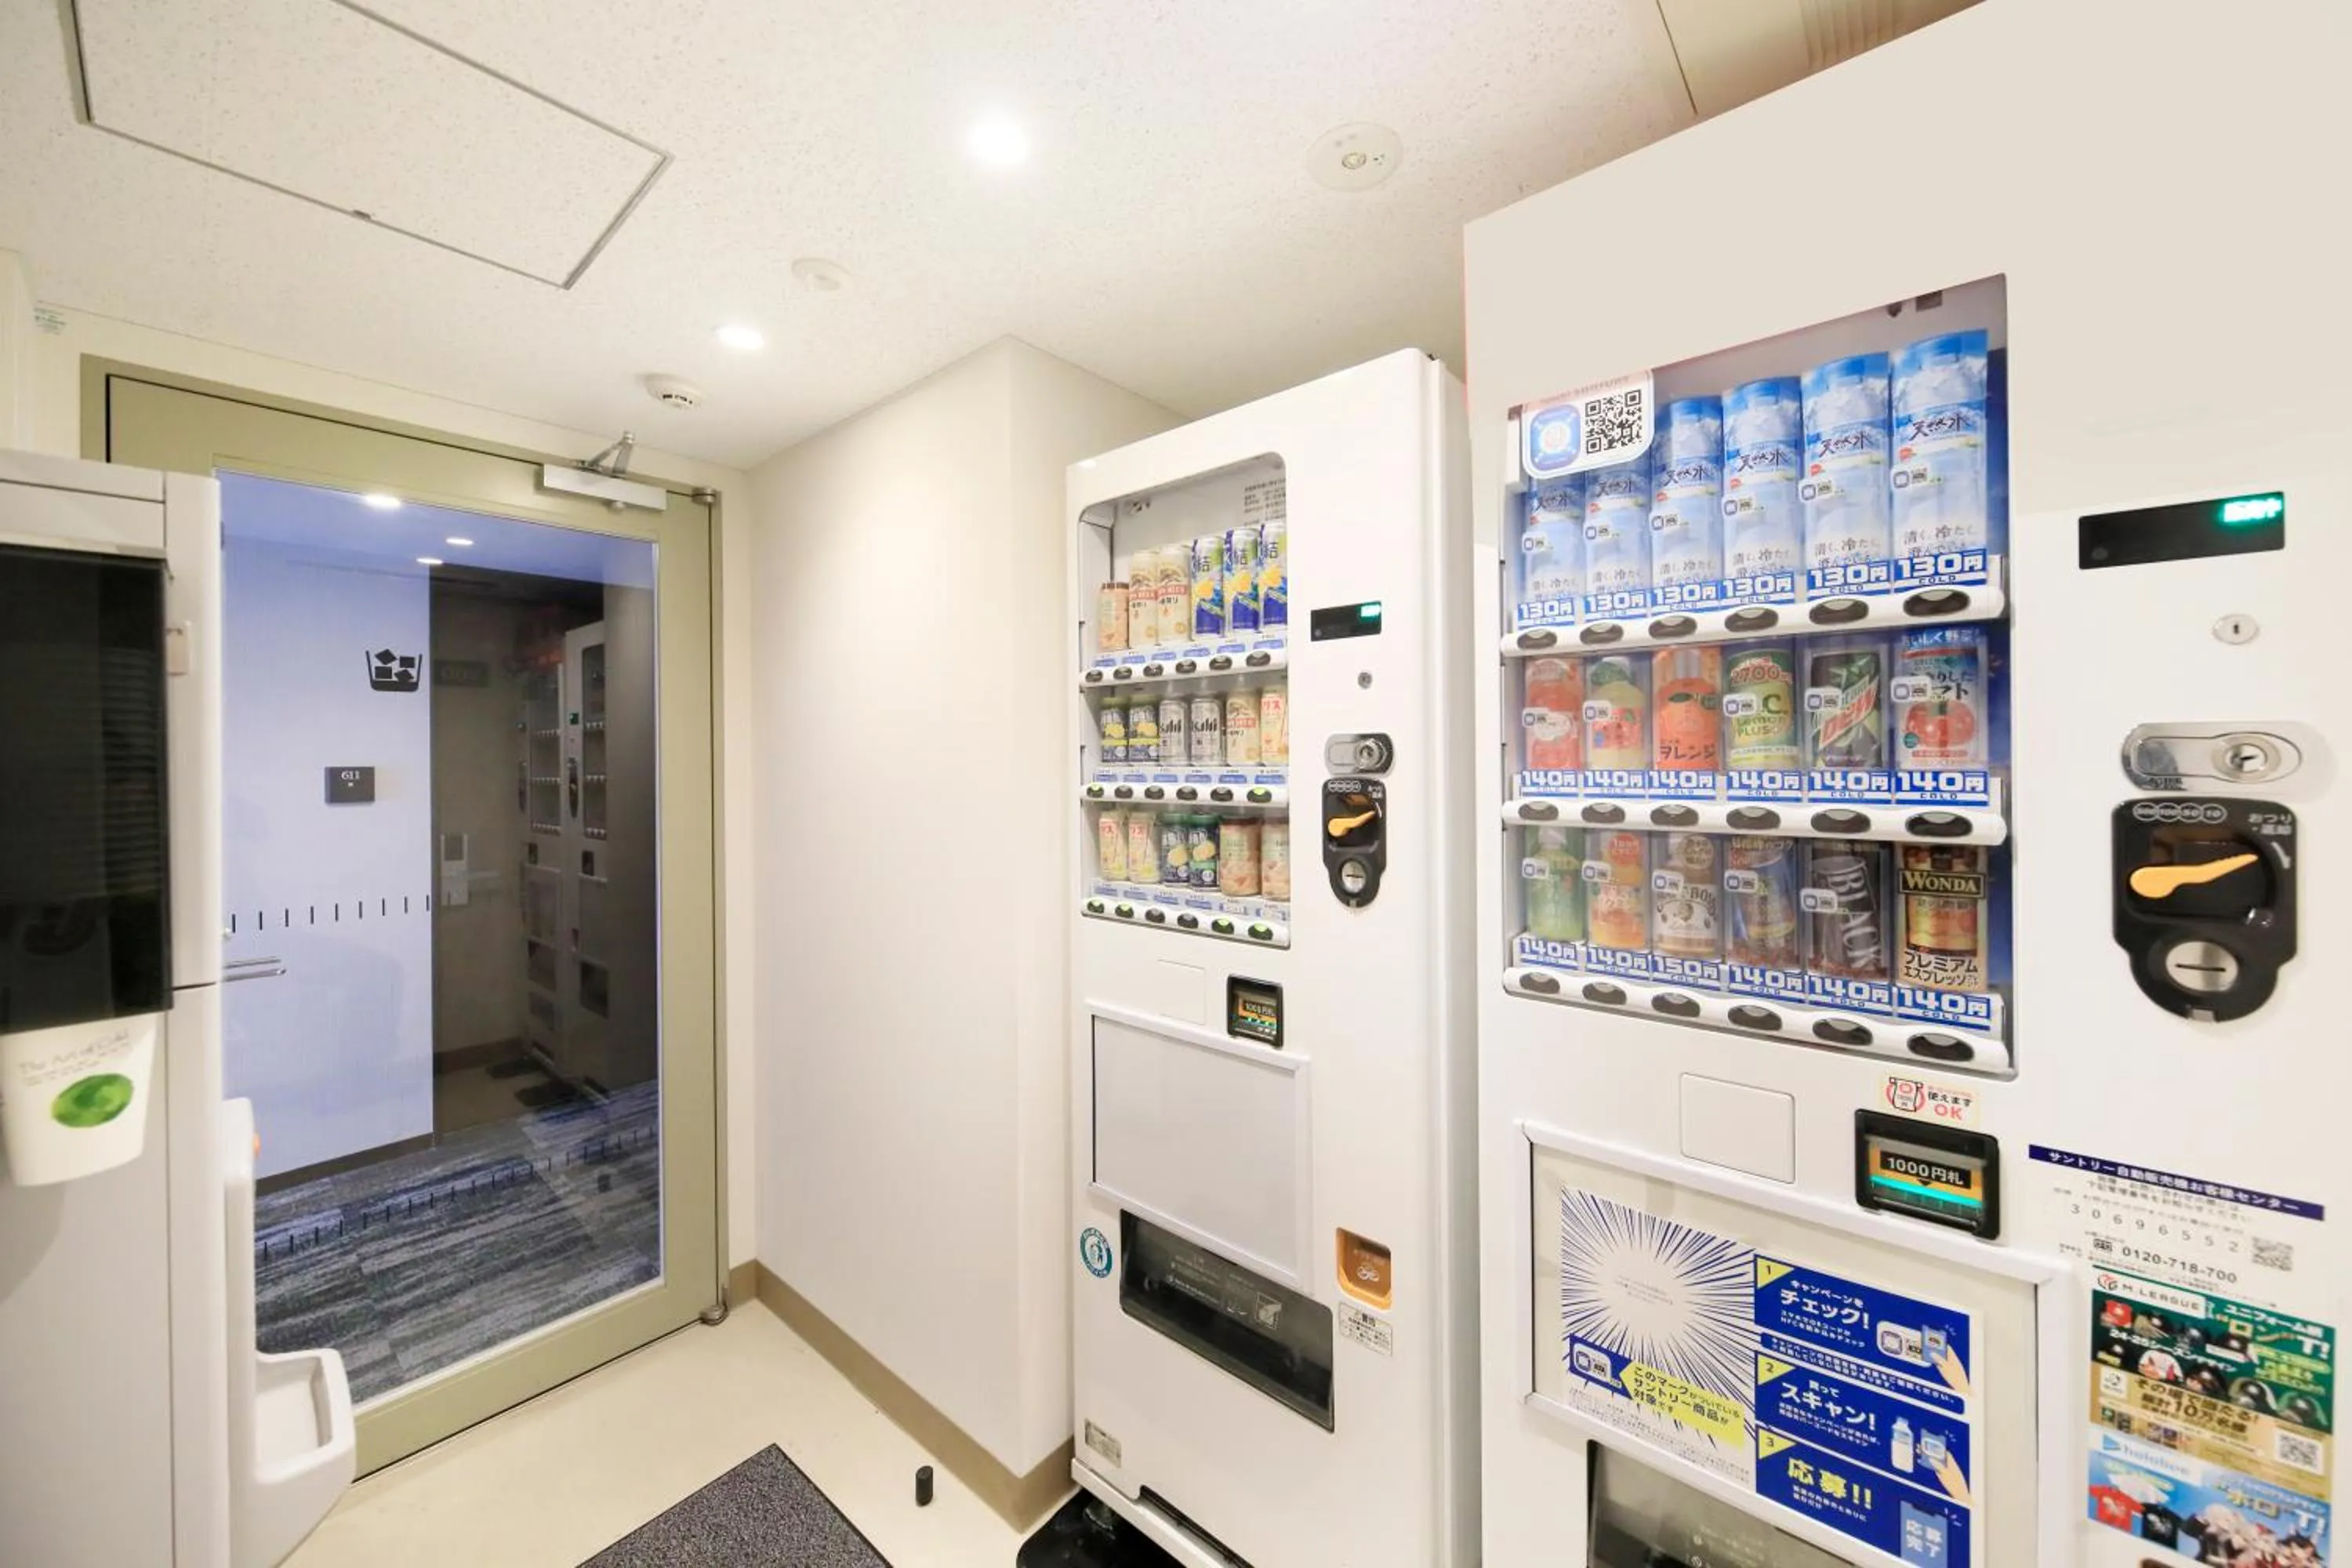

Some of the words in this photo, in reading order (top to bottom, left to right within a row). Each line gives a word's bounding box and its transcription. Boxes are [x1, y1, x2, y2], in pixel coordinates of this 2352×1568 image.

[1809, 562, 1889, 587] 130円
[1897, 551, 1984, 578] 130円
[1653, 583, 1718, 605] 130円
[1725, 575, 1791, 597] 130円
[1521, 601, 1573, 617] 130円
[1586, 592, 1645, 613] 130円
[1522, 771, 1575, 786] 140円
[1584, 771, 1644, 787] 140円
[1650, 771, 1714, 788] 140円
[1728, 771, 1800, 790] 140円
[1809, 771, 1889, 792] 140円
[1897, 771, 1986, 792] 140円
[2207, 809, 2221, 818] 10
[1904, 870, 1978, 893] WONDA
[1521, 938, 1576, 960] 140円
[1587, 946, 1647, 971] 140円
[1653, 955, 1720, 978] 150円
[1904, 951, 1979, 974] プレミアム
[1731, 965, 1802, 992] 140円
[1808, 975, 1889, 1005] 140円
[1899, 986, 1991, 1018] 140円
[1934, 1104, 1962, 1120] OK
[1887, 1157, 1964, 1185] 1000円札
[2122, 1246, 2238, 1284] 0120-718-700
[1790, 1279, 1865, 1308] キャンペーンを
[1780, 1288, 1871, 1330] チェック!
[1780, 1381, 1876, 1431] スキャン!
